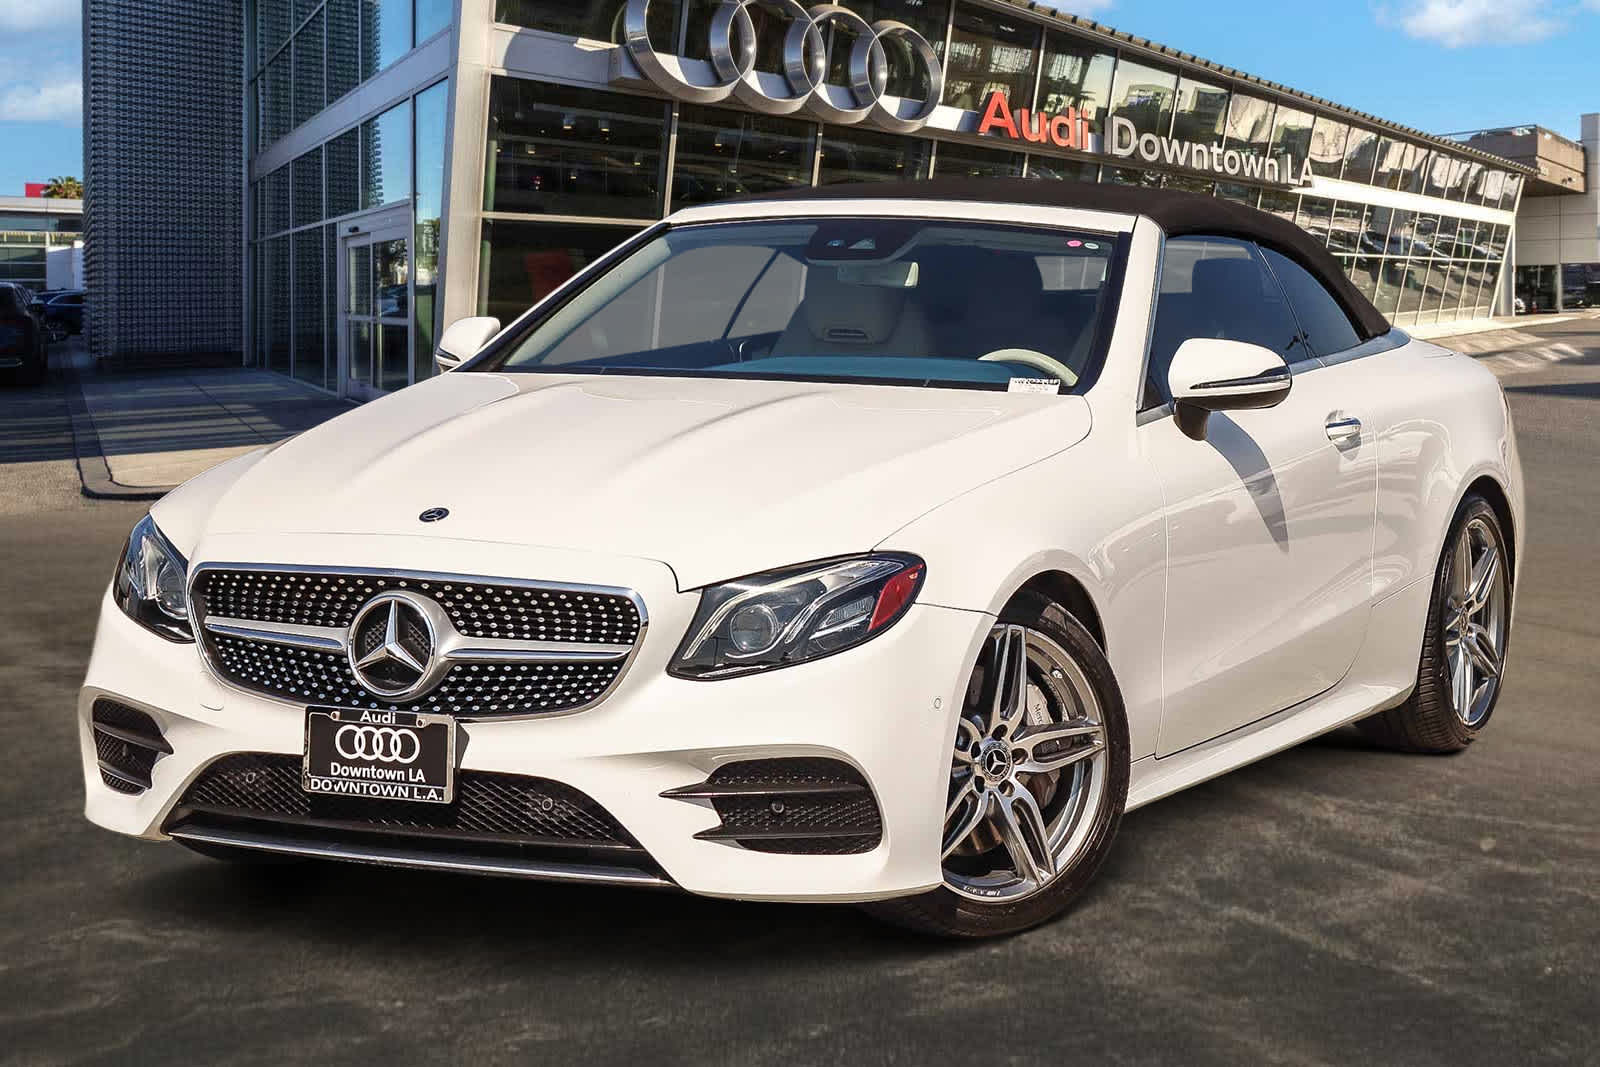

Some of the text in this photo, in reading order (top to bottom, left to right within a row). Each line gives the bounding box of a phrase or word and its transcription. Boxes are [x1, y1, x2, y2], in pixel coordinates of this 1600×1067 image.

[978, 91, 1315, 188] Audi Downtown LA
[360, 710, 396, 724] Audi
[330, 762, 426, 783] Downtown LA
[310, 778, 443, 800] DOWNTOWN L.A.
